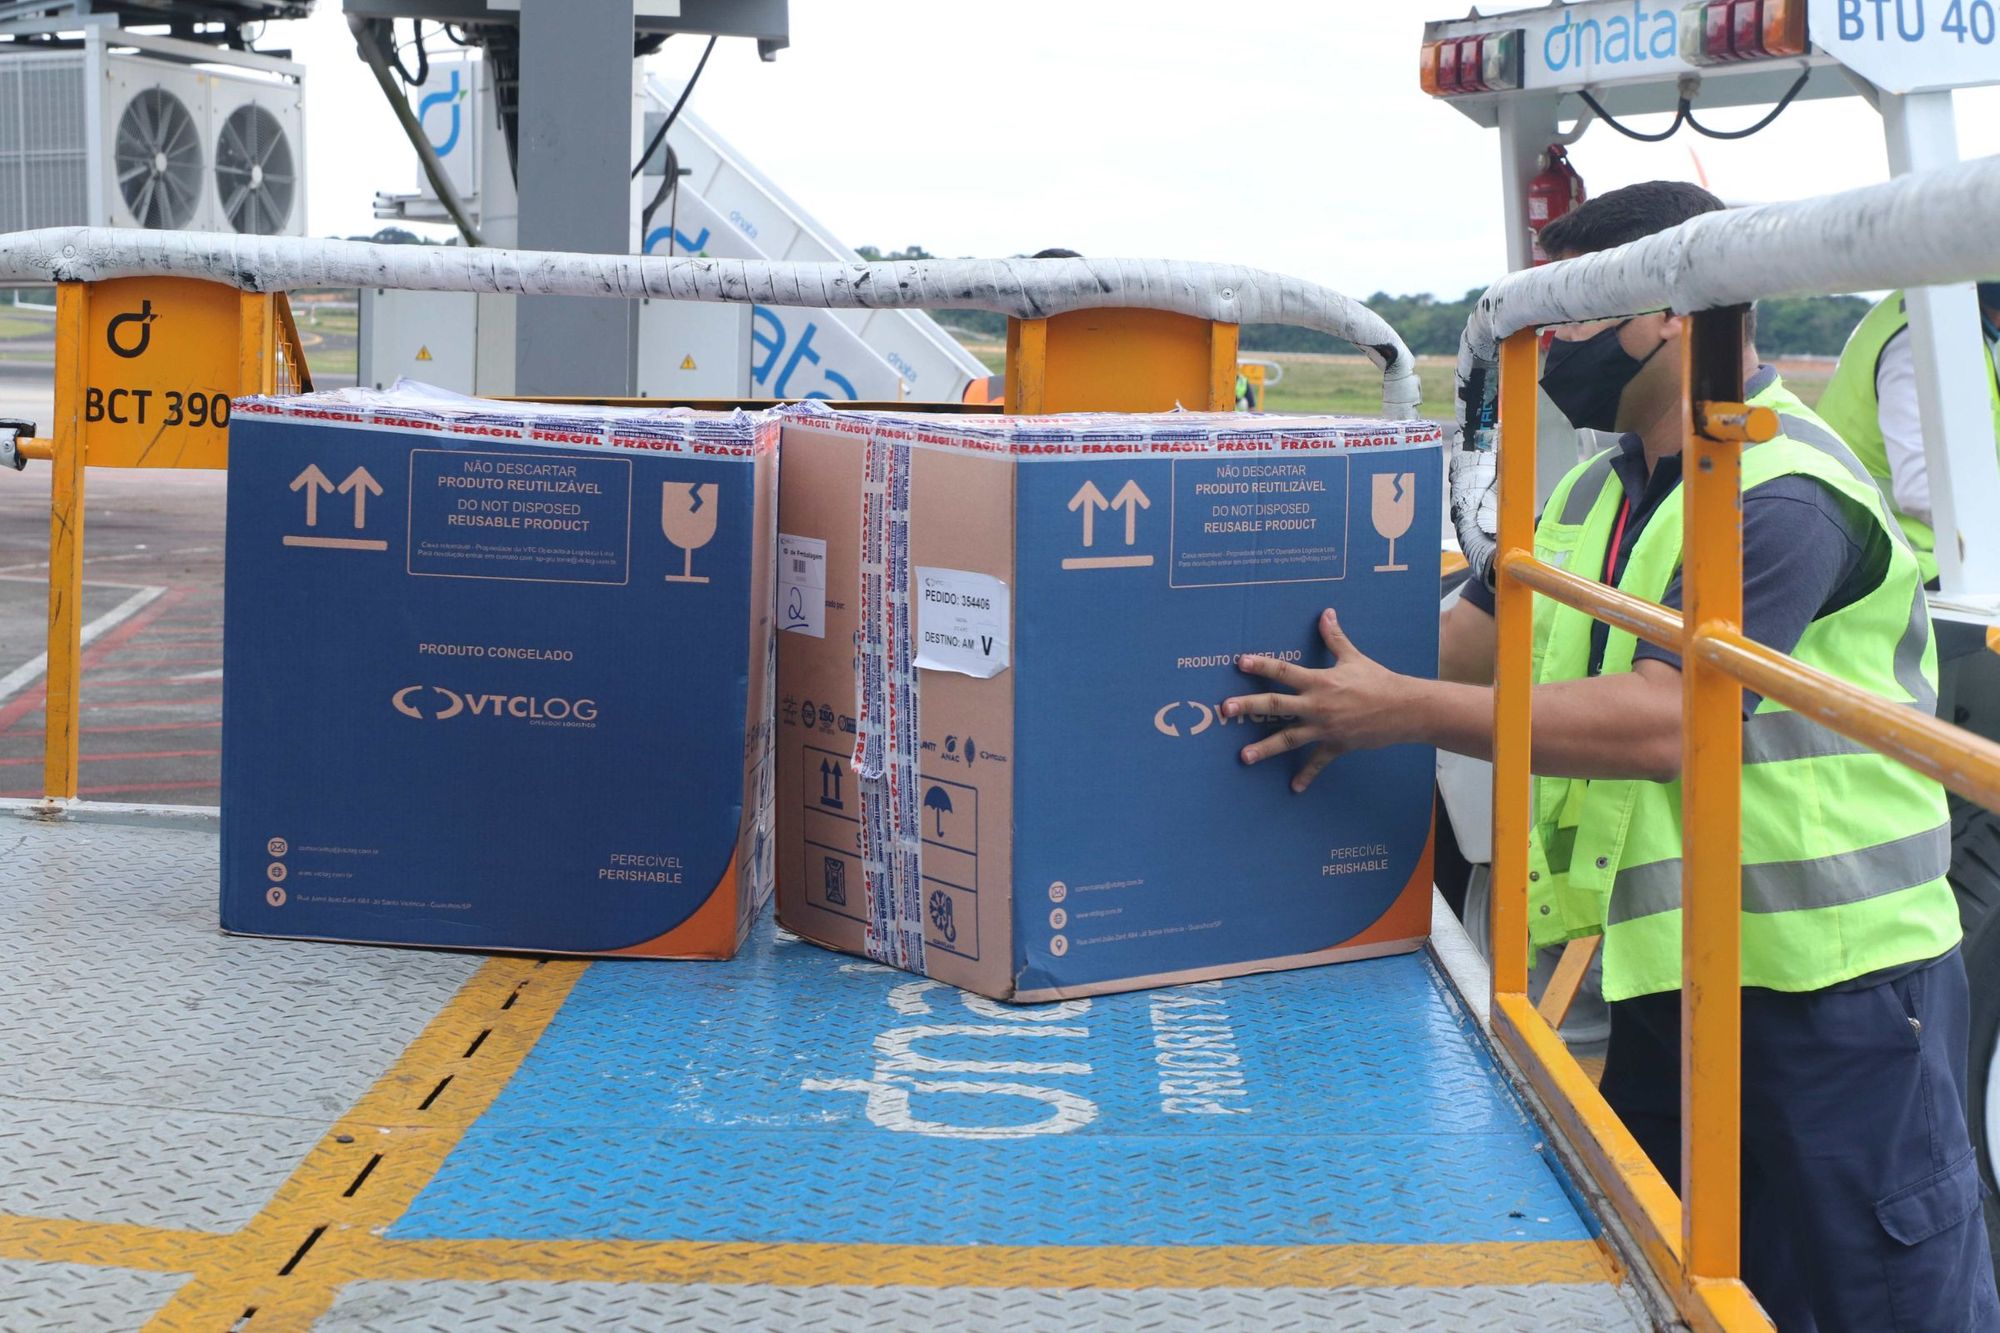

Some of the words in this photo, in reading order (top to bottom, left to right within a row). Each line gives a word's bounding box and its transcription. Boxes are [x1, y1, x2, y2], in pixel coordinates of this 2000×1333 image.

[1838, 0, 1924, 42] BTU
[1941, 0, 2000, 45] 40
[1544, 0, 1677, 71] dnata
[86, 387, 152, 424] BCT
[163, 391, 231, 428] 390
[453, 425, 523, 439] FRÁGIL
[533, 432, 603, 446] FRÁGIL
[694, 445, 754, 457] FRÁGI
[1010, 442, 1073, 454] FRÁGIL
[1082, 442, 1142, 453] FRÁGIL
[1151, 442, 1209, 452] FRÁGIL
[1217, 440, 1273, 451] FRÁGIL
[1281, 439, 1337, 450] FRÁGIL
[1344, 435, 1398, 448] FRÁGIL
[464, 460, 492, 473] NÃO
[497, 463, 577, 477] DESCARTAR
[1217, 465, 1239, 478] NÃO
[1242, 464, 1306, 477] DESCARTAR
[438, 476, 504, 490] PRODUTO
[507, 479, 602, 495] REUTILIZÁVEL
[1195, 483, 1249, 495] PRODUTO
[1252, 479, 1326, 493] REUTILIZÁVEL
[458, 499, 477, 510] DO
[481, 500, 509, 512] NOT
[513, 501, 581, 515] DISPOSED
[1212, 505, 1228, 517] DO
[1231, 504, 1253, 516] NOT
[1255, 503, 1310, 516] DISPOSED
[448, 514, 520, 528] REUSABLE
[524, 518, 590, 532] PRODUCT
[1204, 520, 1262, 533] REUSABLE
[1265, 518, 1316, 531] PRODUCT
[925, 589, 960, 605] PEDIDO:
[961, 595, 990, 610] 354406
[925, 631, 960, 647] DESTINO:
[962, 638, 975, 649] AM
[981, 635, 993, 656] V
[419, 643, 484, 656] PRODUTO
[487, 647, 573, 661] CONGELADO
[1177, 654, 1230, 668] PRODUTO
[464, 694, 598, 720] VTCLOG
[941, 753, 960, 762] ANAC
[610, 853, 683, 868] PERECÍVEL
[1330, 844, 1388, 859] PERECÍVEL
[599, 868, 682, 883] PERISHABLE
[1322, 859, 1388, 876] PERISHABLE
[1149, 995, 1252, 1114] PRIORITY
